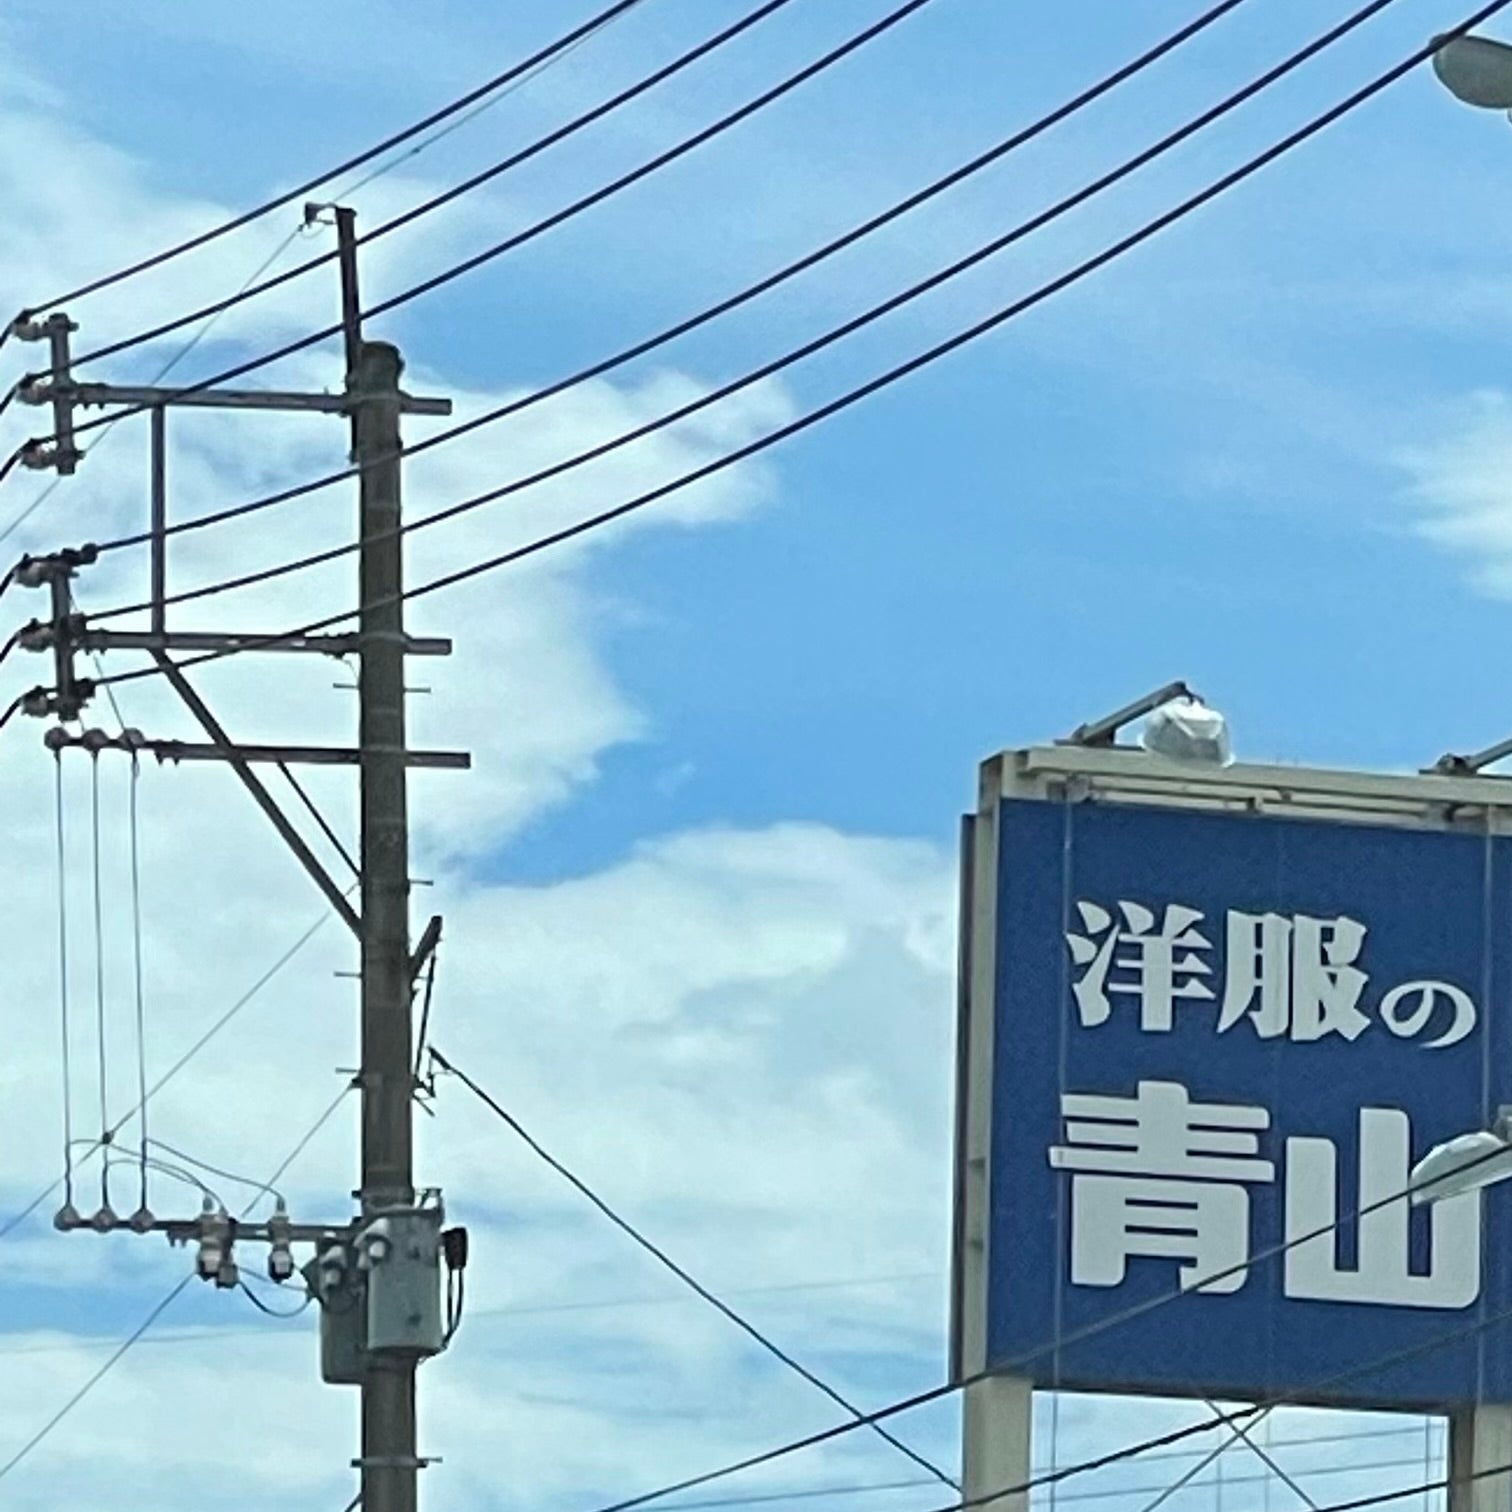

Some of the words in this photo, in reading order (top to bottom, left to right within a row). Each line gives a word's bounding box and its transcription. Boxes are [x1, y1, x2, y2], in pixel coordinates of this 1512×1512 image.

[1064, 899, 1478, 1049] 洋服の
[1048, 1080, 1482, 1310] 青山
